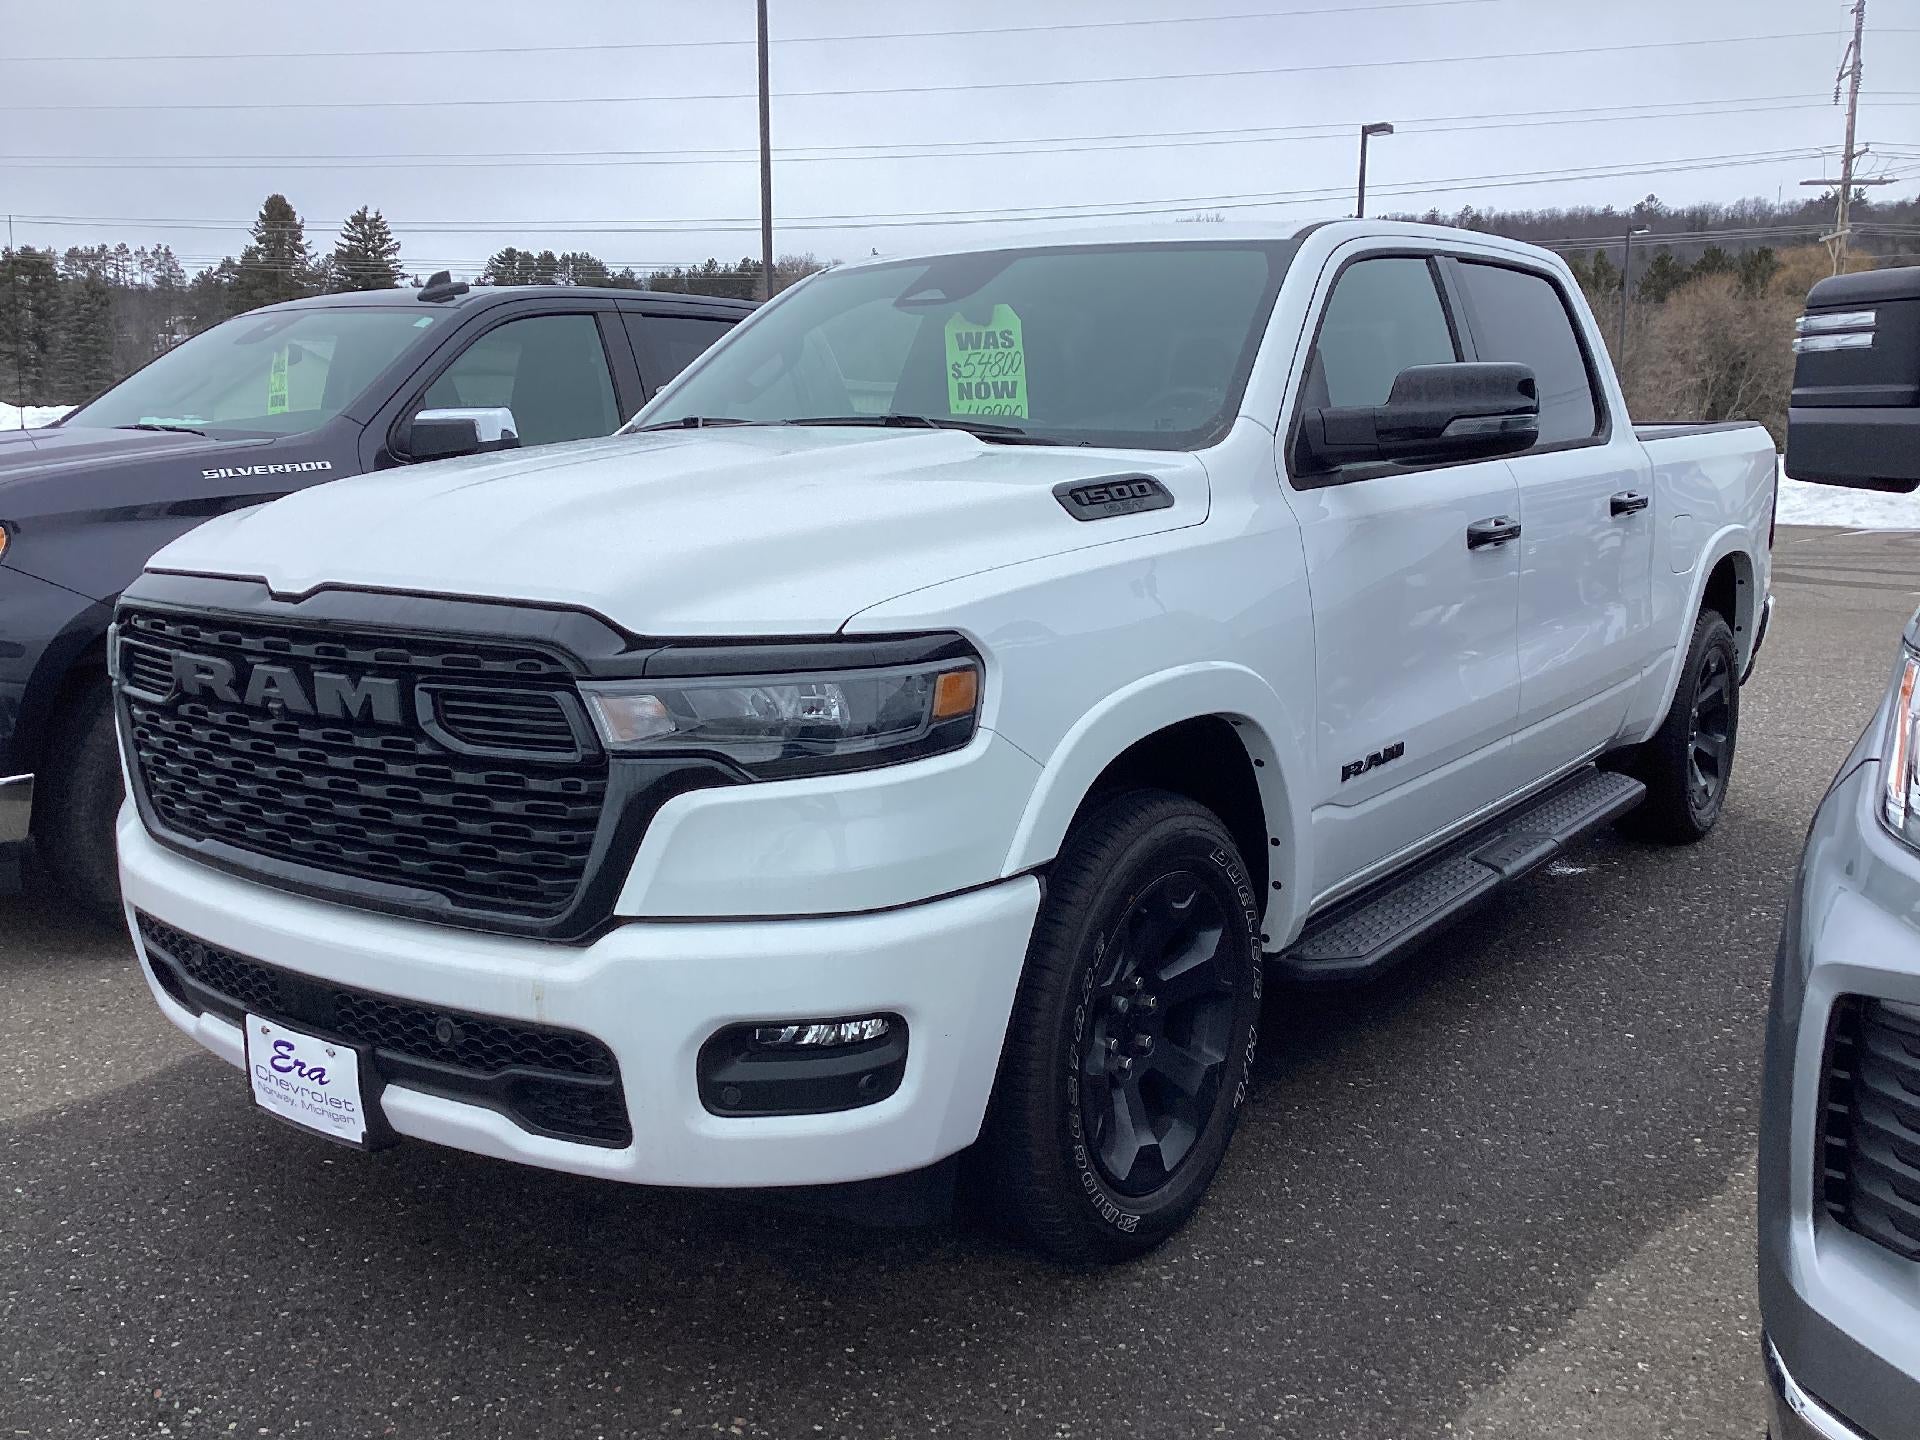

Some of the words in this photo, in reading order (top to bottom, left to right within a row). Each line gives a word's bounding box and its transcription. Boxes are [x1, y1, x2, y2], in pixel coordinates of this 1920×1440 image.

[955, 329, 1015, 351] WAS
[951, 351, 1022, 381] $54800
[957, 381, 1018, 401] NOW
[202, 460, 332, 479] SILVERADO
[1069, 481, 1154, 505] 1500
[175, 650, 401, 726] RAM
[1341, 741, 1405, 782] RAM
[1208, 847, 1263, 1001] DUELER
[270, 1039, 331, 1085] Era
[1066, 930, 1141, 1234] BRIDGESTONE
[255, 1064, 355, 1112] Chevrolet
[257, 1080, 297, 1107] Norway,
[301, 1100, 356, 1125] Michigan
